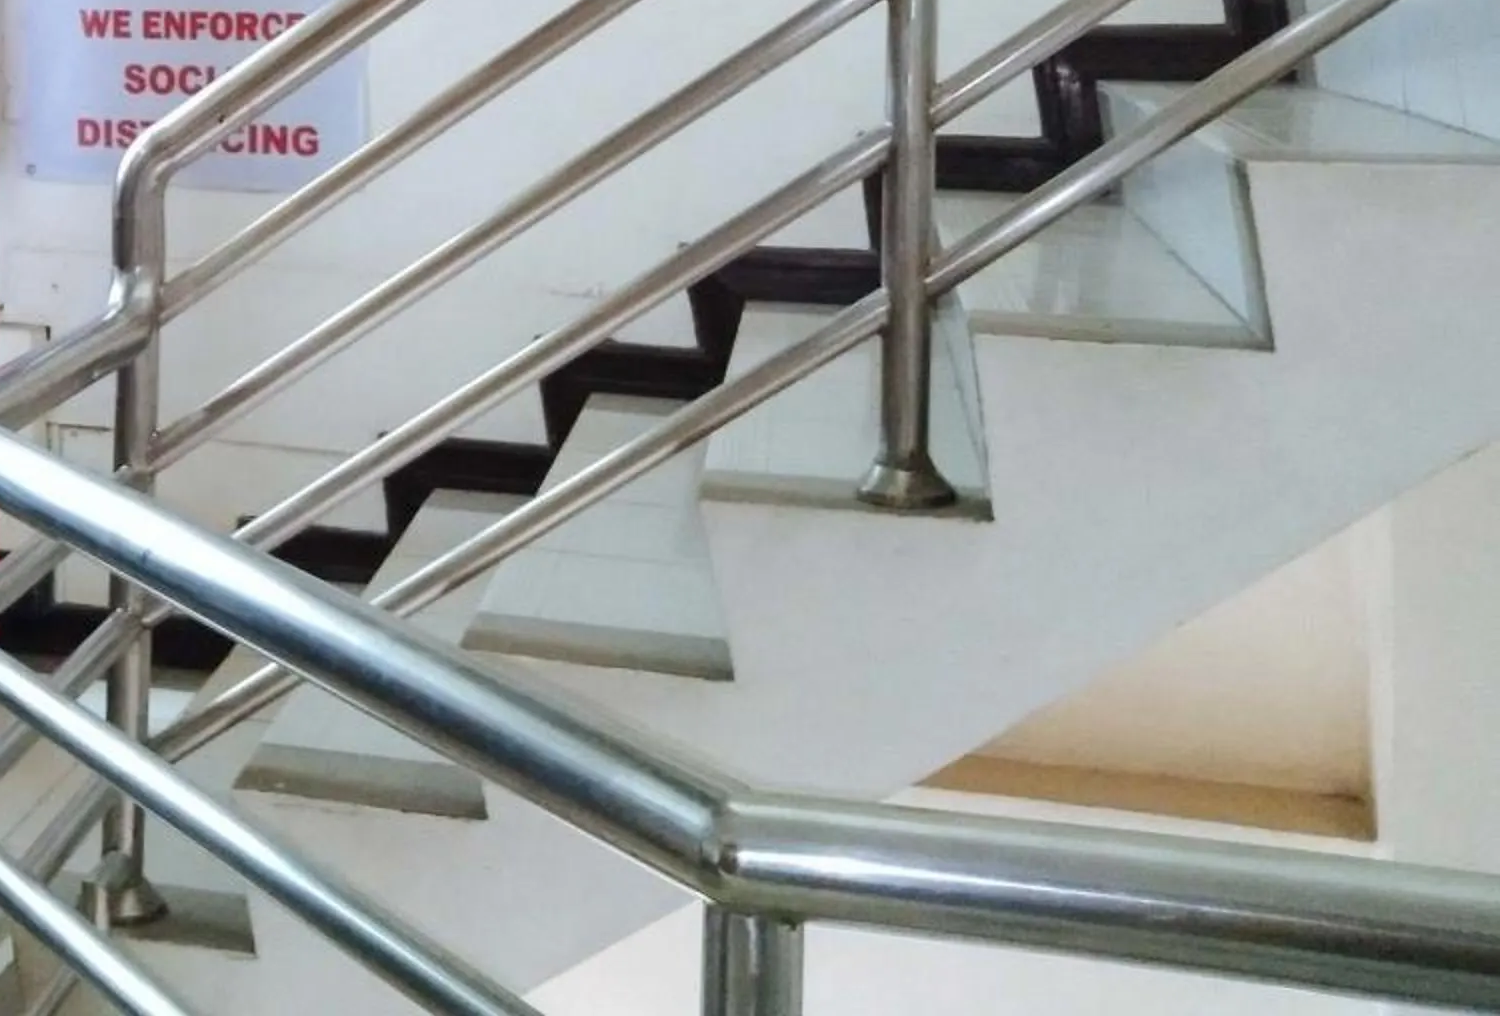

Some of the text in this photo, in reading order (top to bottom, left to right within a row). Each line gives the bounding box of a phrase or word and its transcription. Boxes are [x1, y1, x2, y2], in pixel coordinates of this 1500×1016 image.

[80, 9, 133, 39] WE
[123, 63, 235, 96] SOCI
[77, 118, 319, 156] DISCING
